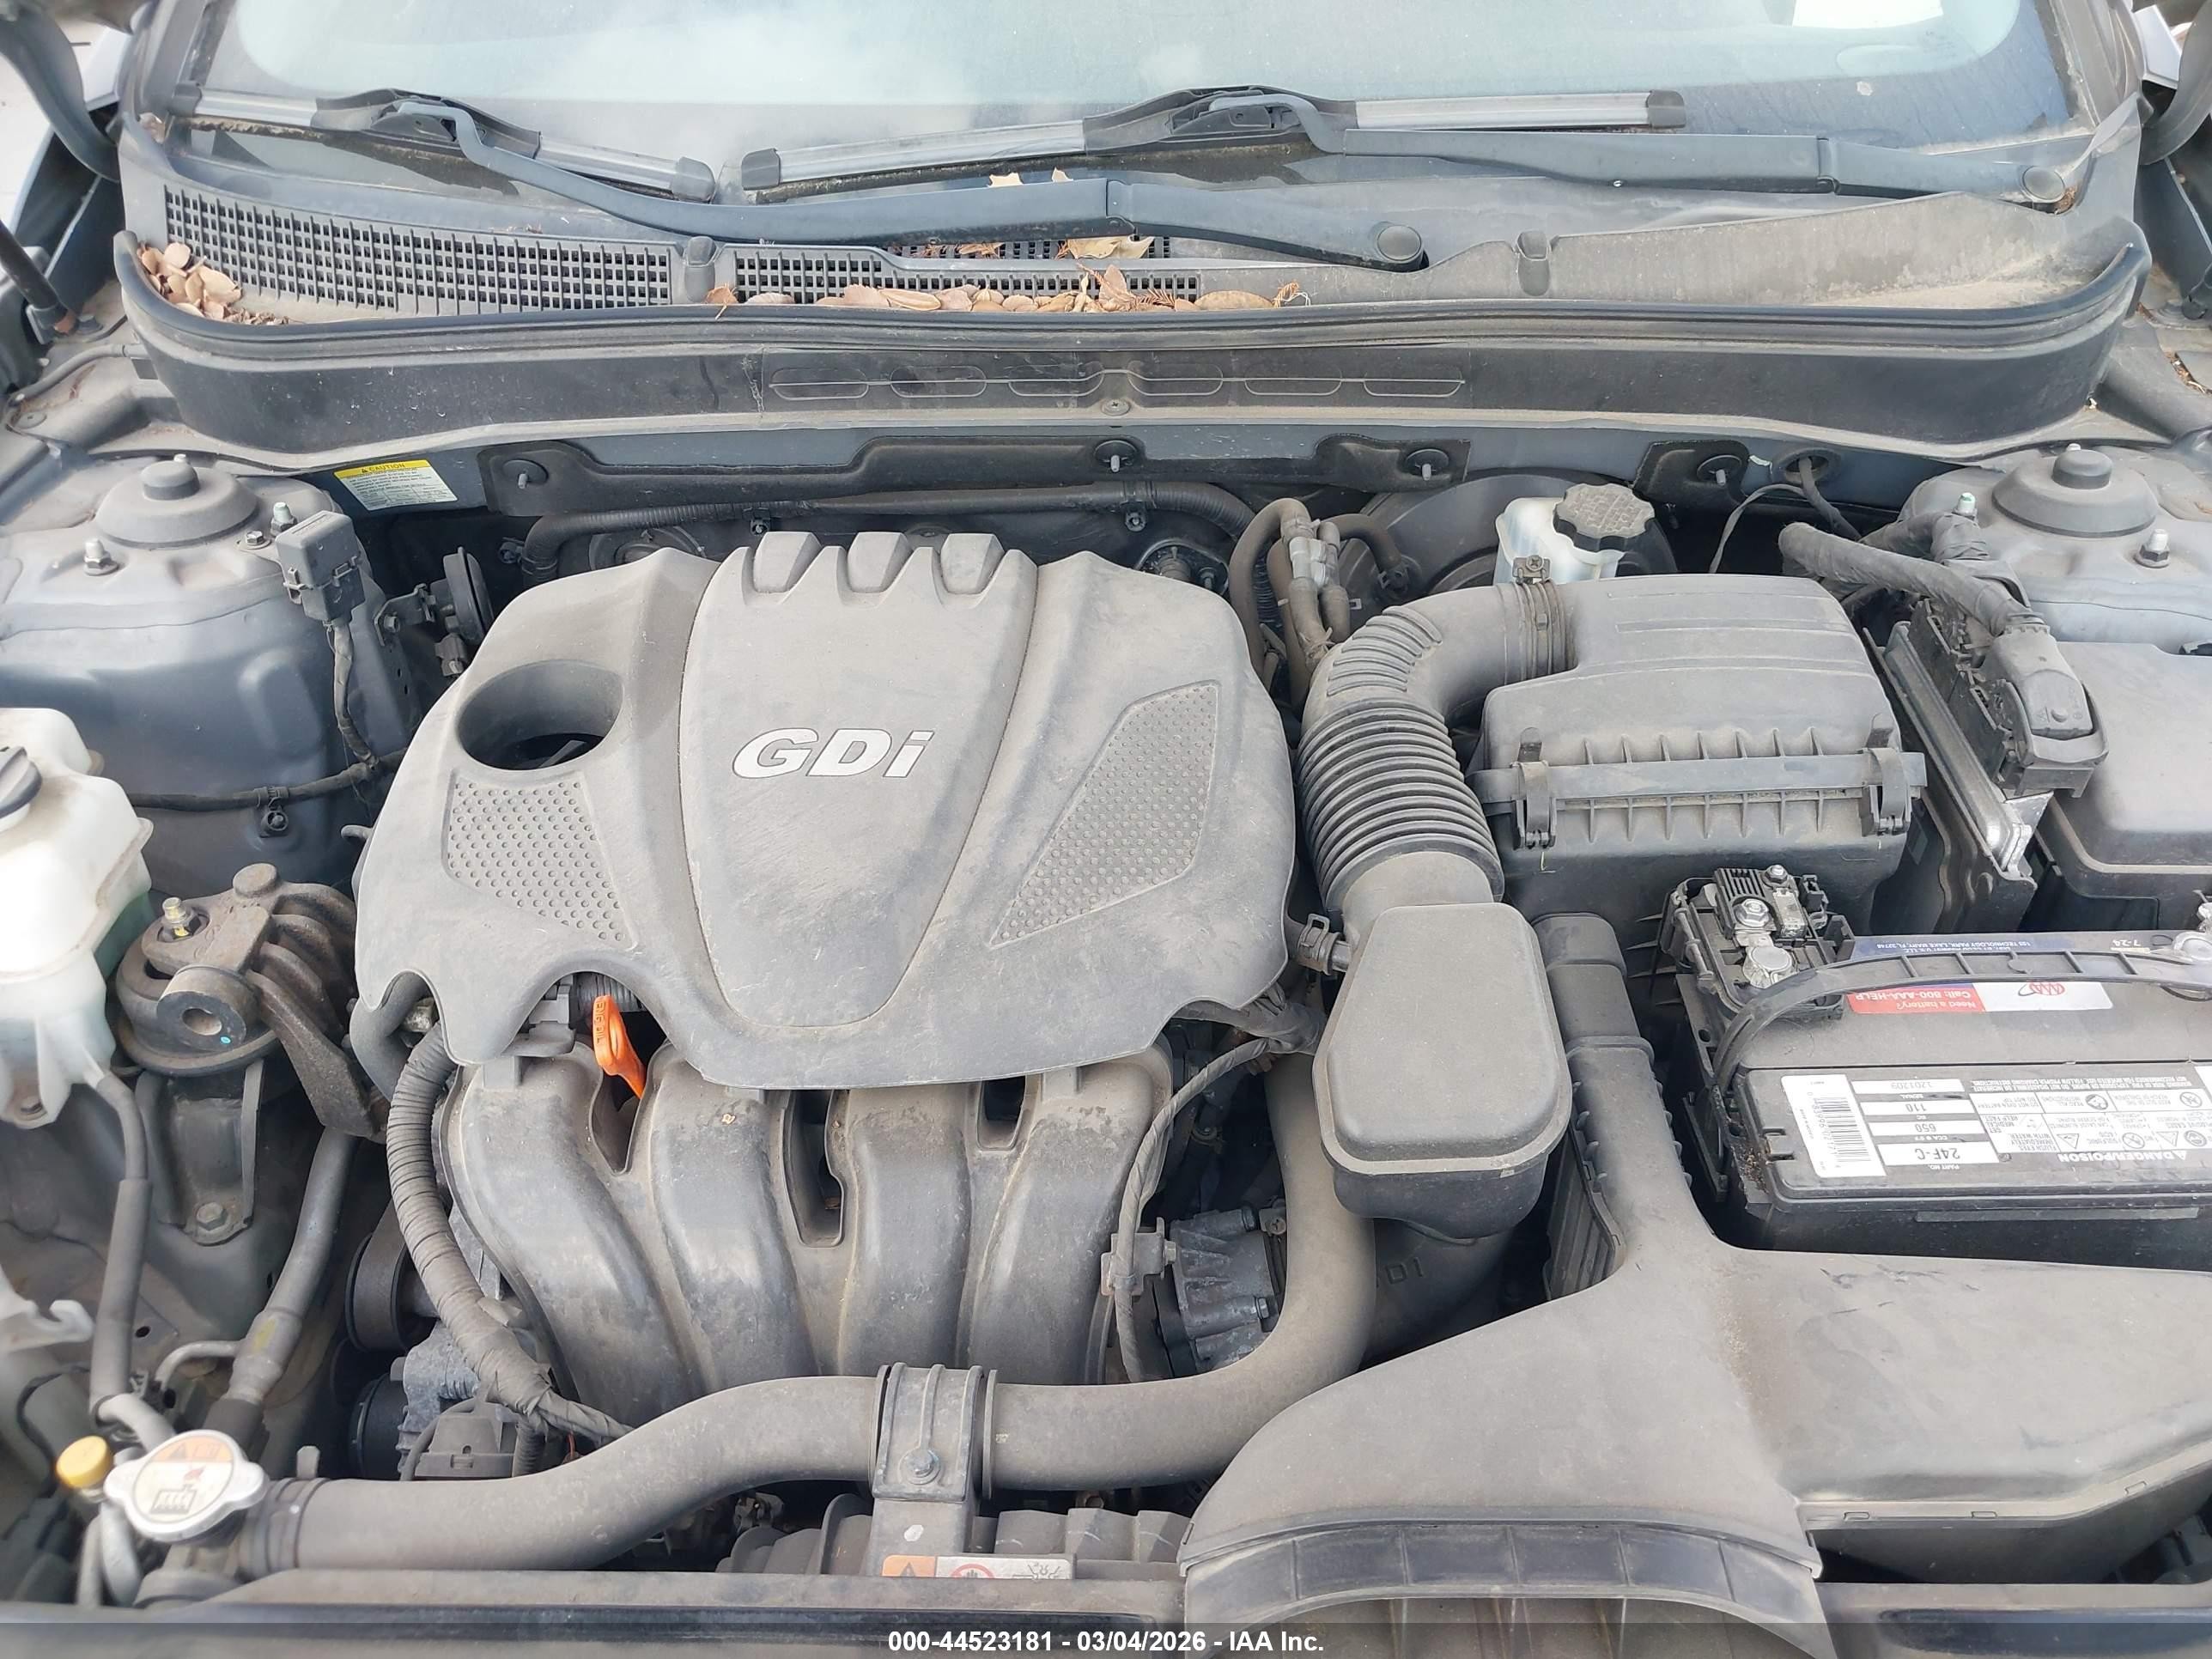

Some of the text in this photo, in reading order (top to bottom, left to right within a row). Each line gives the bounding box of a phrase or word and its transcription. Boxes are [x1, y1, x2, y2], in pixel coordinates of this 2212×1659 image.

[368, 463, 405, 471] CAUTION
[732, 727, 935, 779] GDi
[2029, 982, 2065, 996] AAA
[1855, 990, 1942, 1000] 800-AAA-HELP
[1896, 1000, 1939, 1010] battery?
[1905, 1103, 1927, 1113] 110
[1915, 1123, 1936, 1133] 650
[1914, 1147, 1960, 1160] 24F-C
[2057, 1151, 2175, 1163] DANGER/POISON
